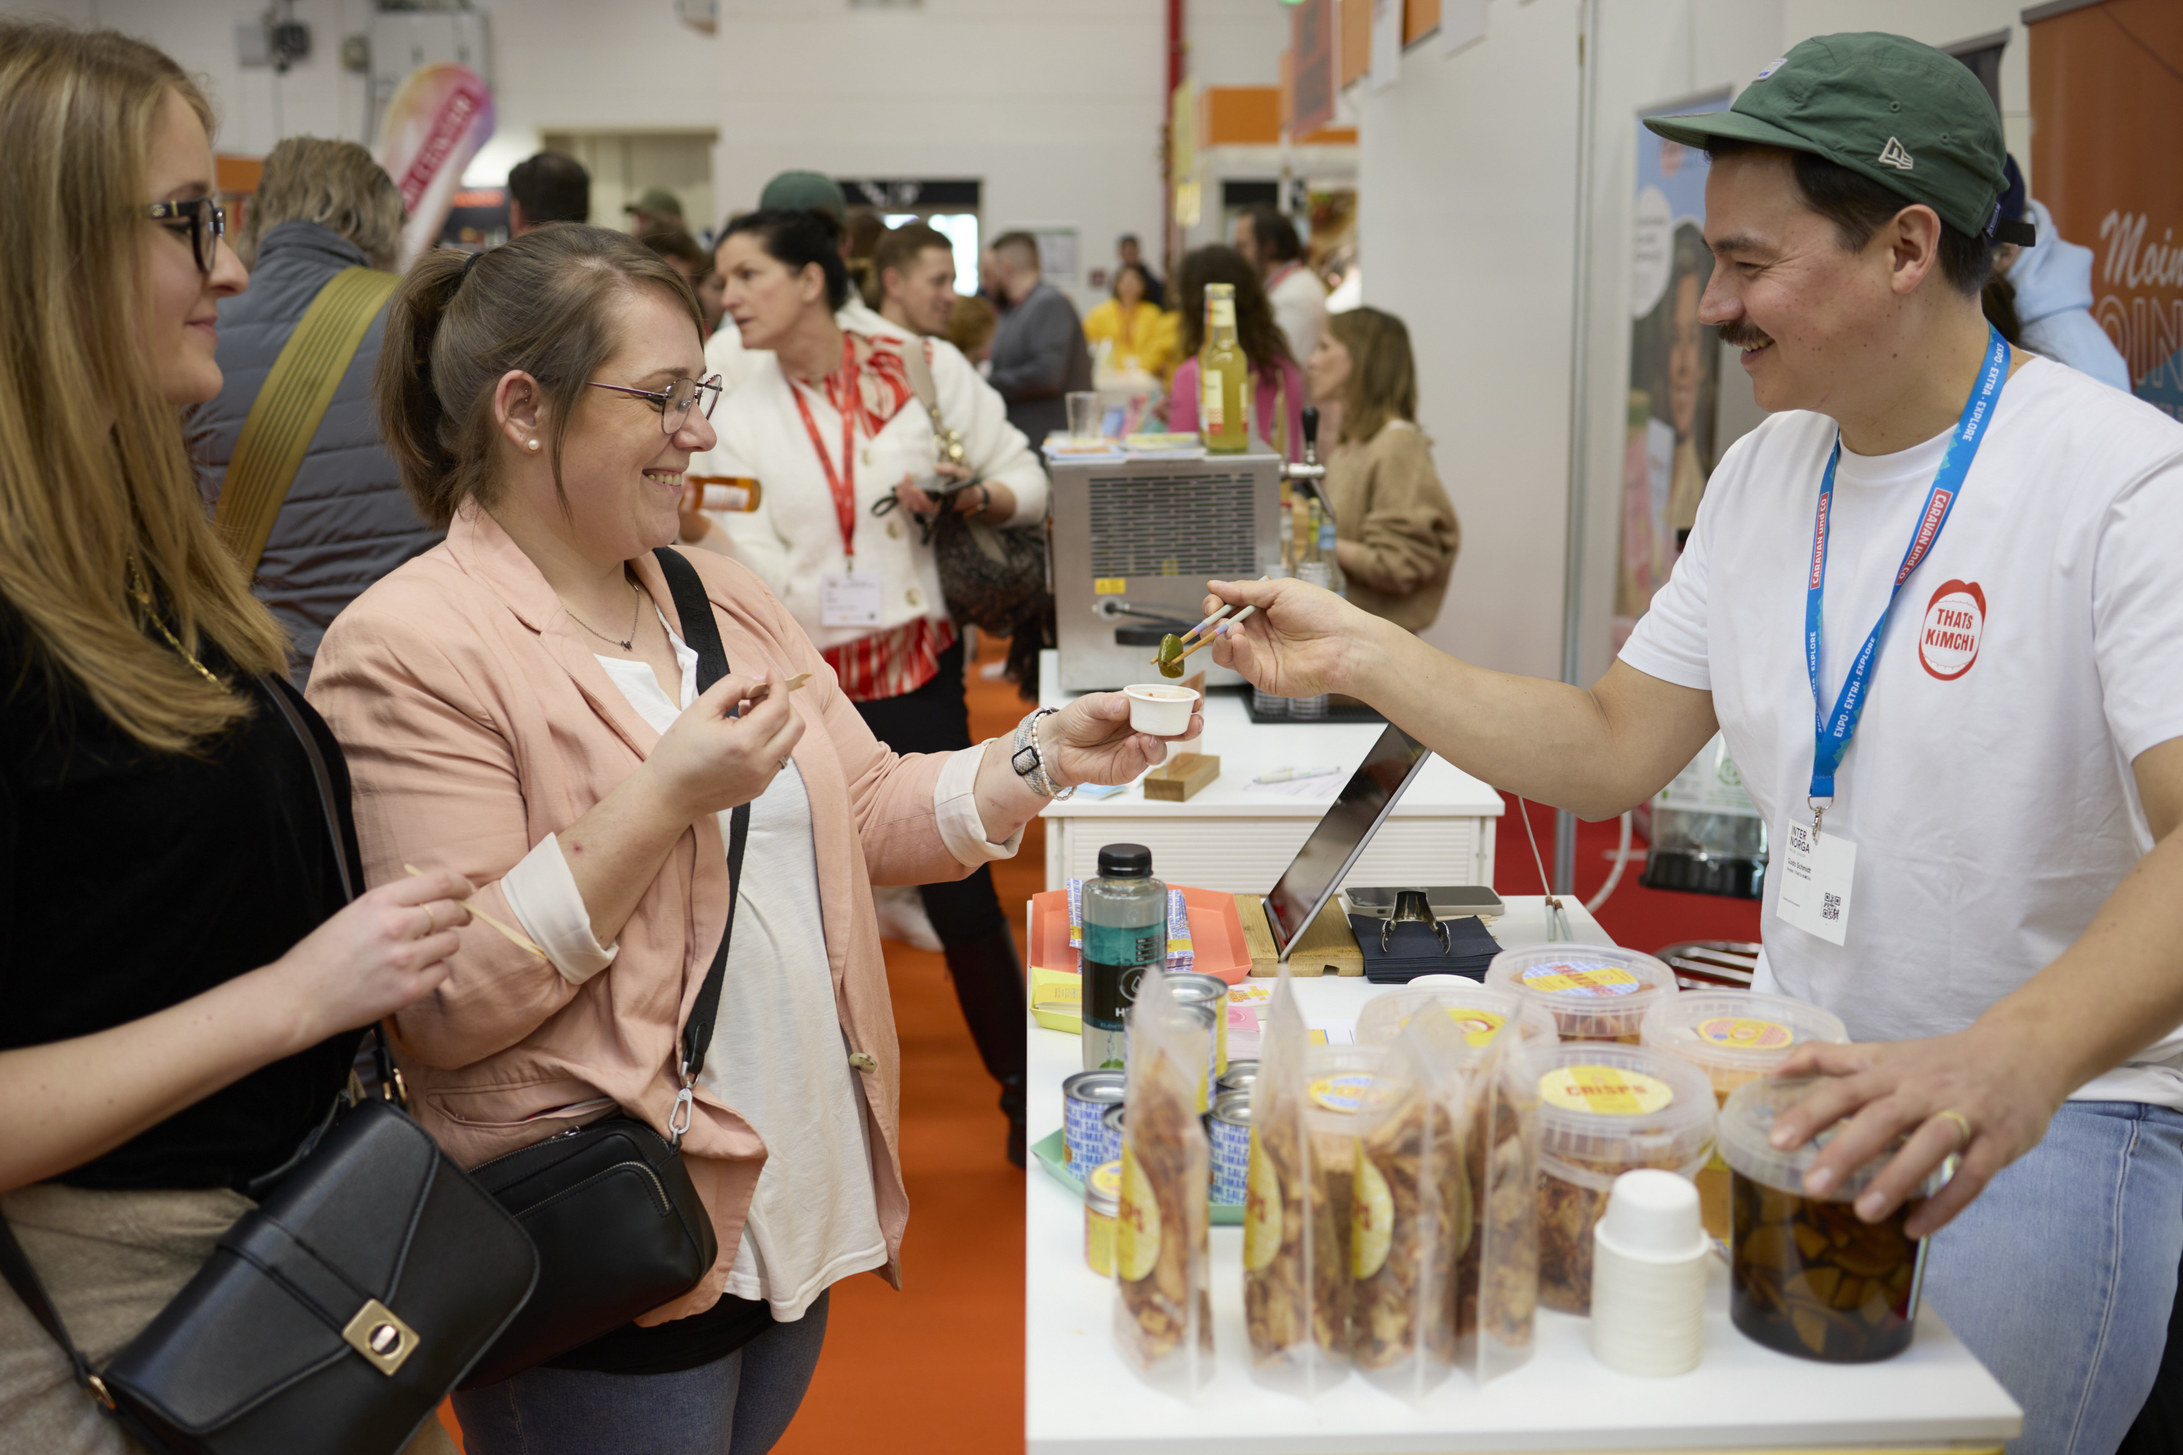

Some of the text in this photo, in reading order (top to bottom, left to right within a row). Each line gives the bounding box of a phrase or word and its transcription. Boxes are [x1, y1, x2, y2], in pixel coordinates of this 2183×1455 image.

[1962, 342, 2005, 442] EXPO EXTRA EXPLORE
[1918, 494, 1947, 545] CARAVAN
[1812, 535, 1823, 584] CARAVAN
[1907, 546, 1924, 567] und
[1833, 636, 1876, 738] EXPO EXTRA EXPLORE
[1790, 836, 1811, 854] NORGA
[1791, 825, 1808, 840] INTER
[1564, 1084, 1648, 1097] CRISPS
